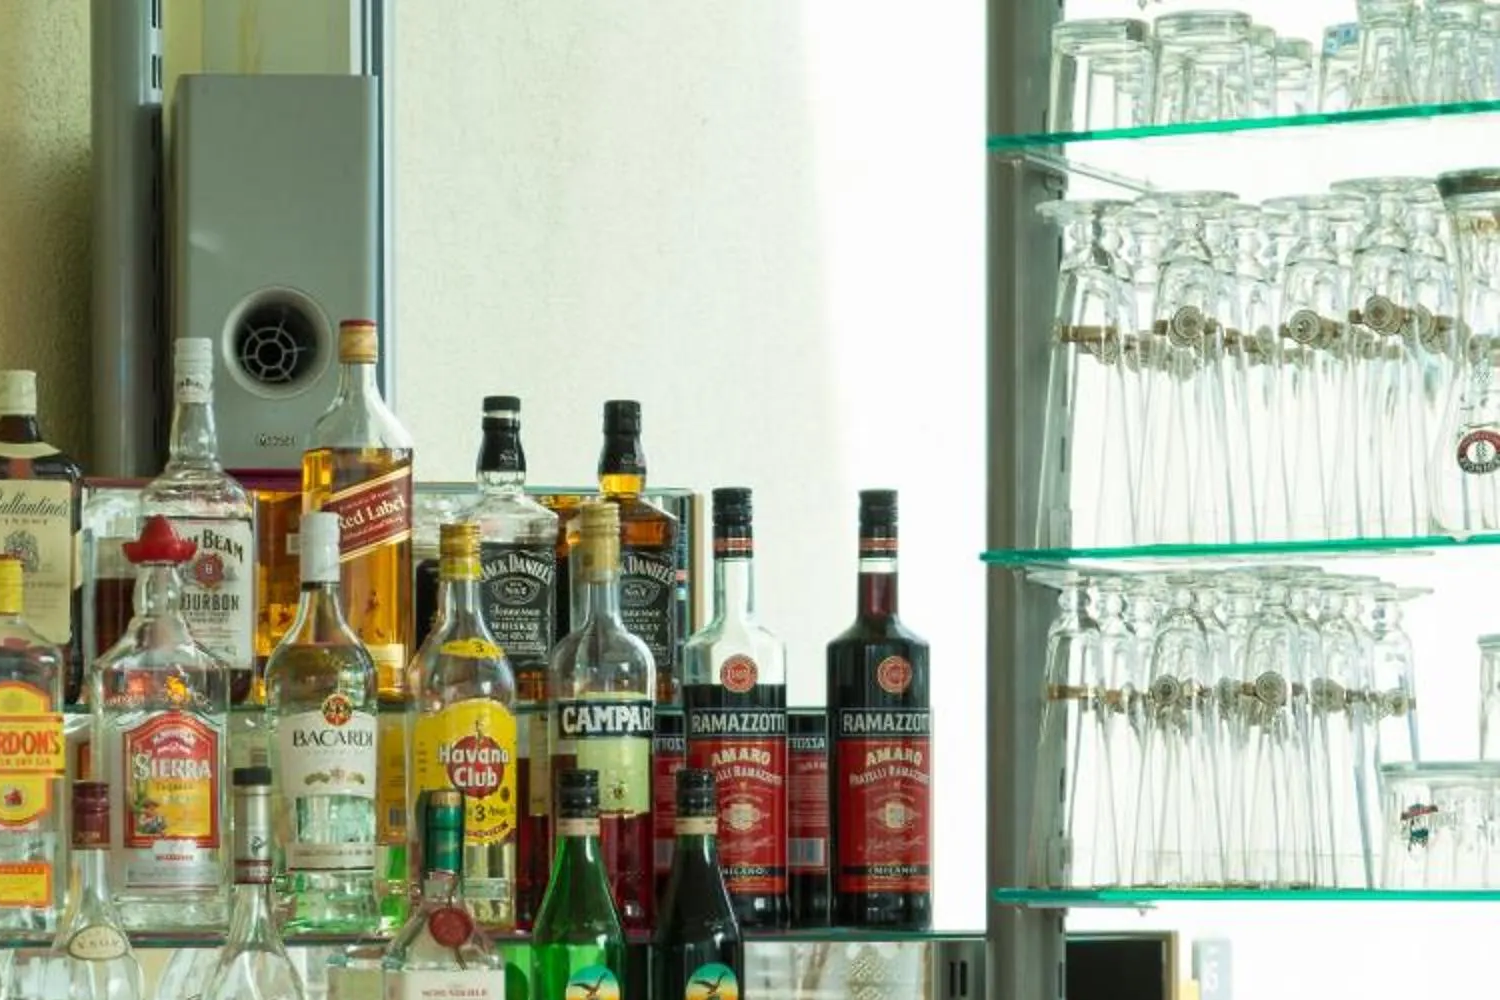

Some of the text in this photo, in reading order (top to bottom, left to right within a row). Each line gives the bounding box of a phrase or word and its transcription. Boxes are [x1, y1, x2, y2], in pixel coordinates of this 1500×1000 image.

[365, 494, 406, 521] Label
[202, 529, 244, 564] BEAM
[691, 713, 786, 733] RAMAZZOTTI
[293, 729, 373, 747] BACARDI
[439, 746, 509, 764] Havana
[711, 747, 771, 766] AMARO
[866, 747, 923, 767] AMARO
[132, 752, 212, 781] SIERRA
[453, 767, 498, 788] Club
[475, 804, 486, 822] 3
